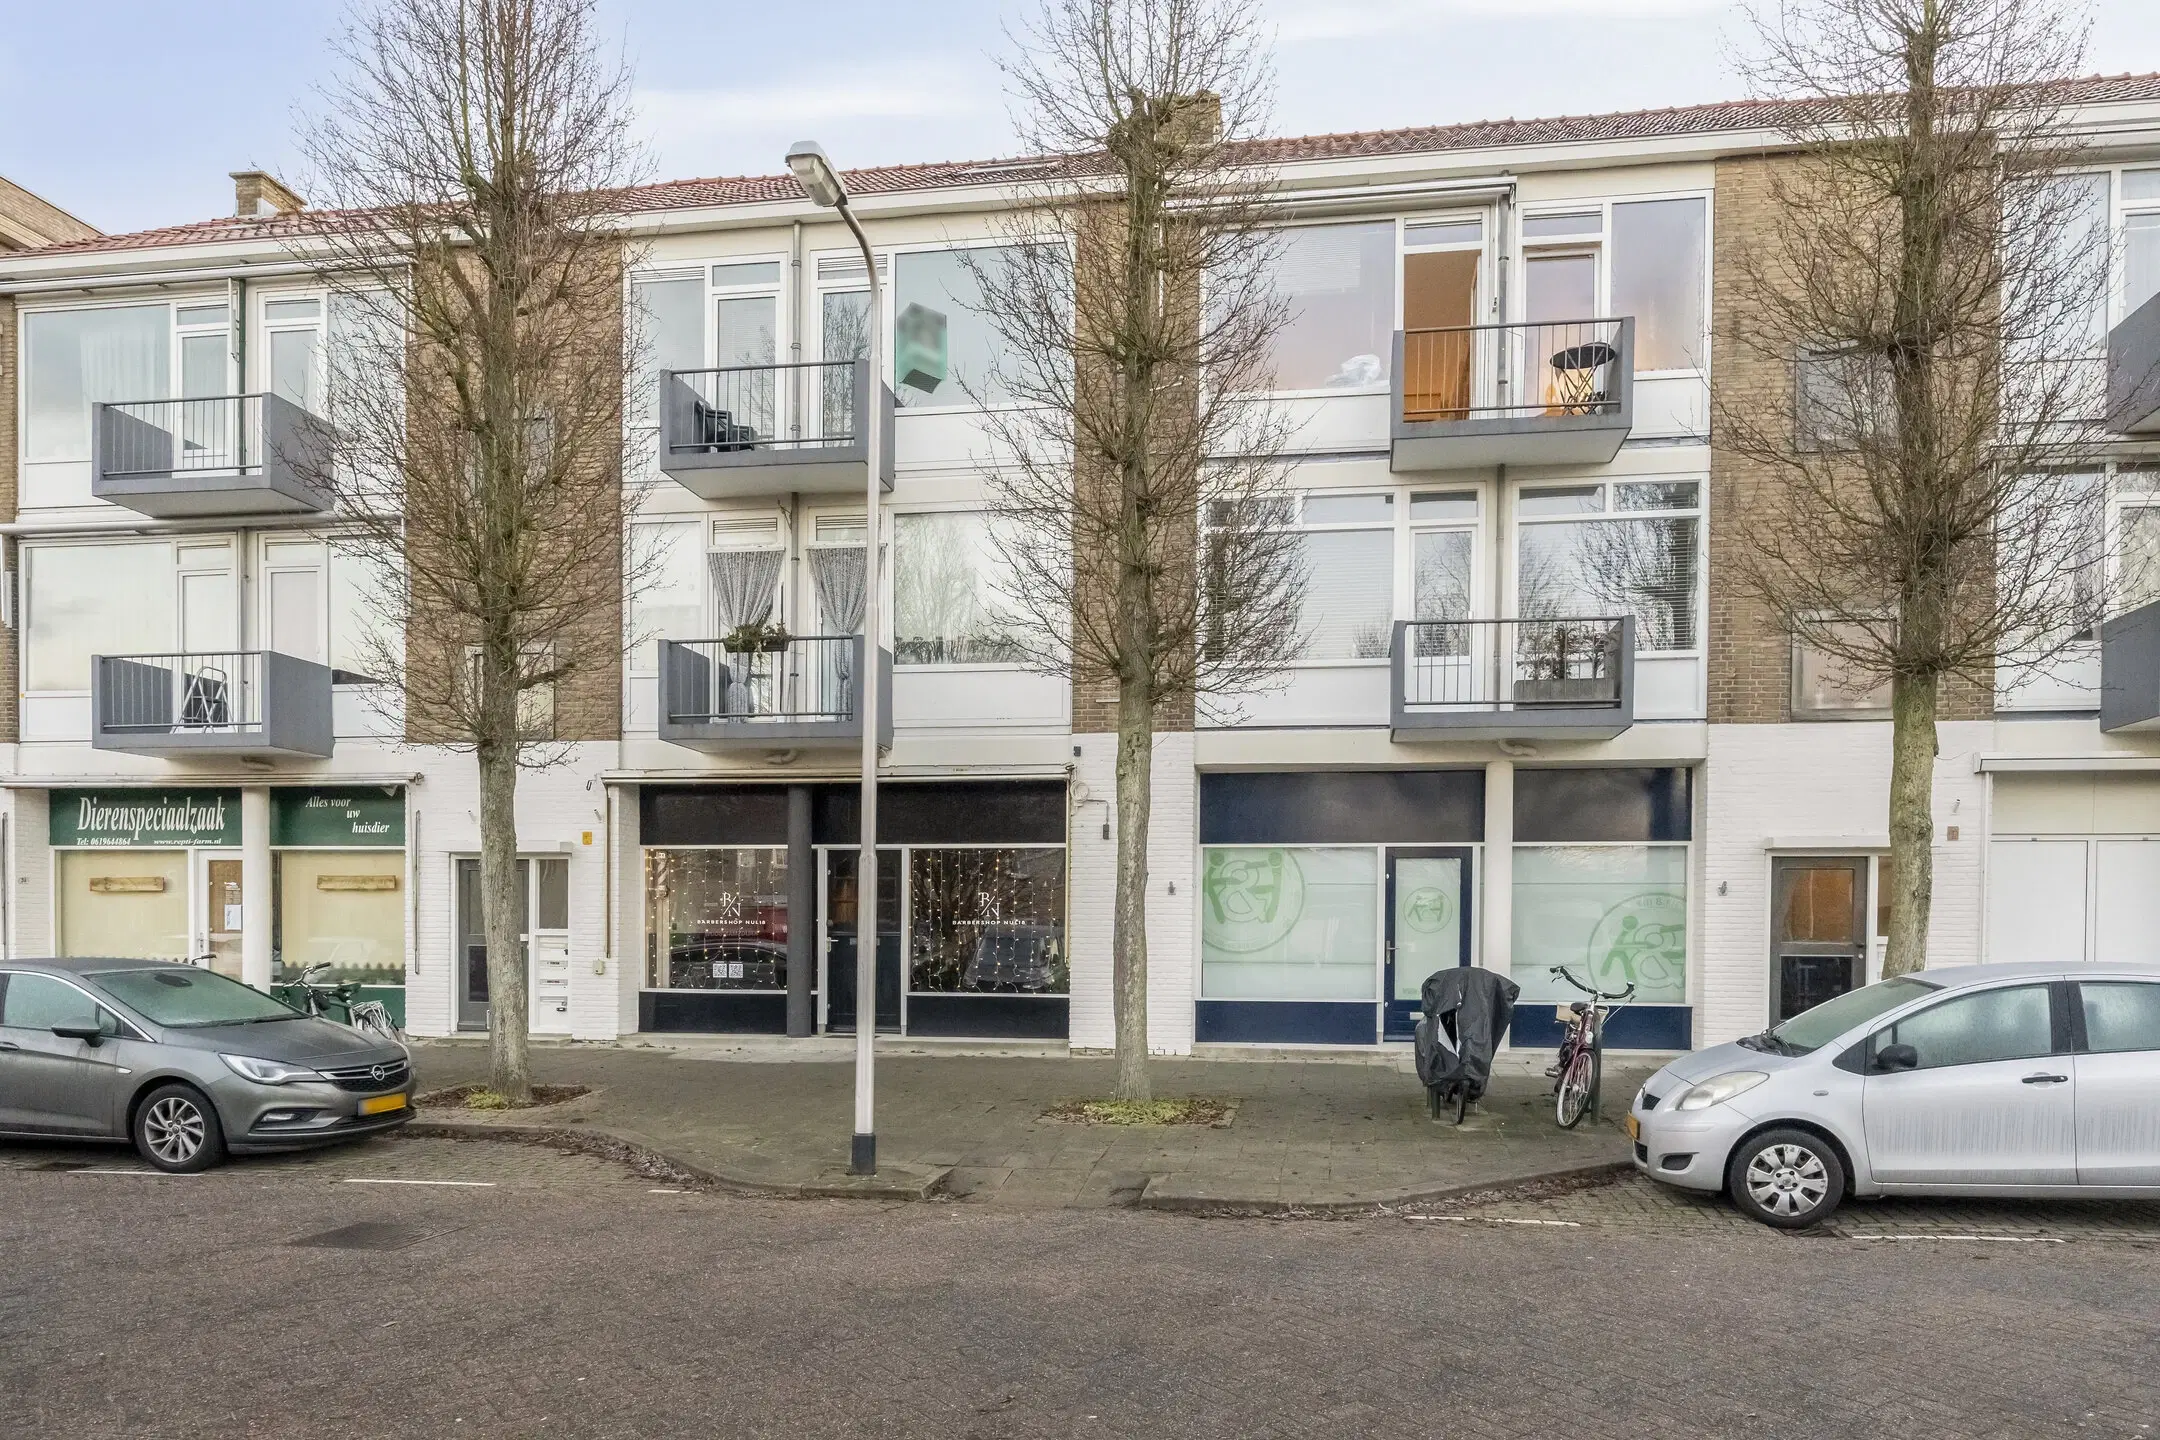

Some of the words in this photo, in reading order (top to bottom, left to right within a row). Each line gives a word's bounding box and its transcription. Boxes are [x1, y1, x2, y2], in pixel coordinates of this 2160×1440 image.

[305, 796, 328, 808] Alles
[330, 798, 352, 808] voor
[77, 796, 226, 841] Dierenspeciaalzaak
[346, 809, 361, 819] uw
[352, 821, 390, 834] huisdier
[76, 837, 89, 846] Tel:
